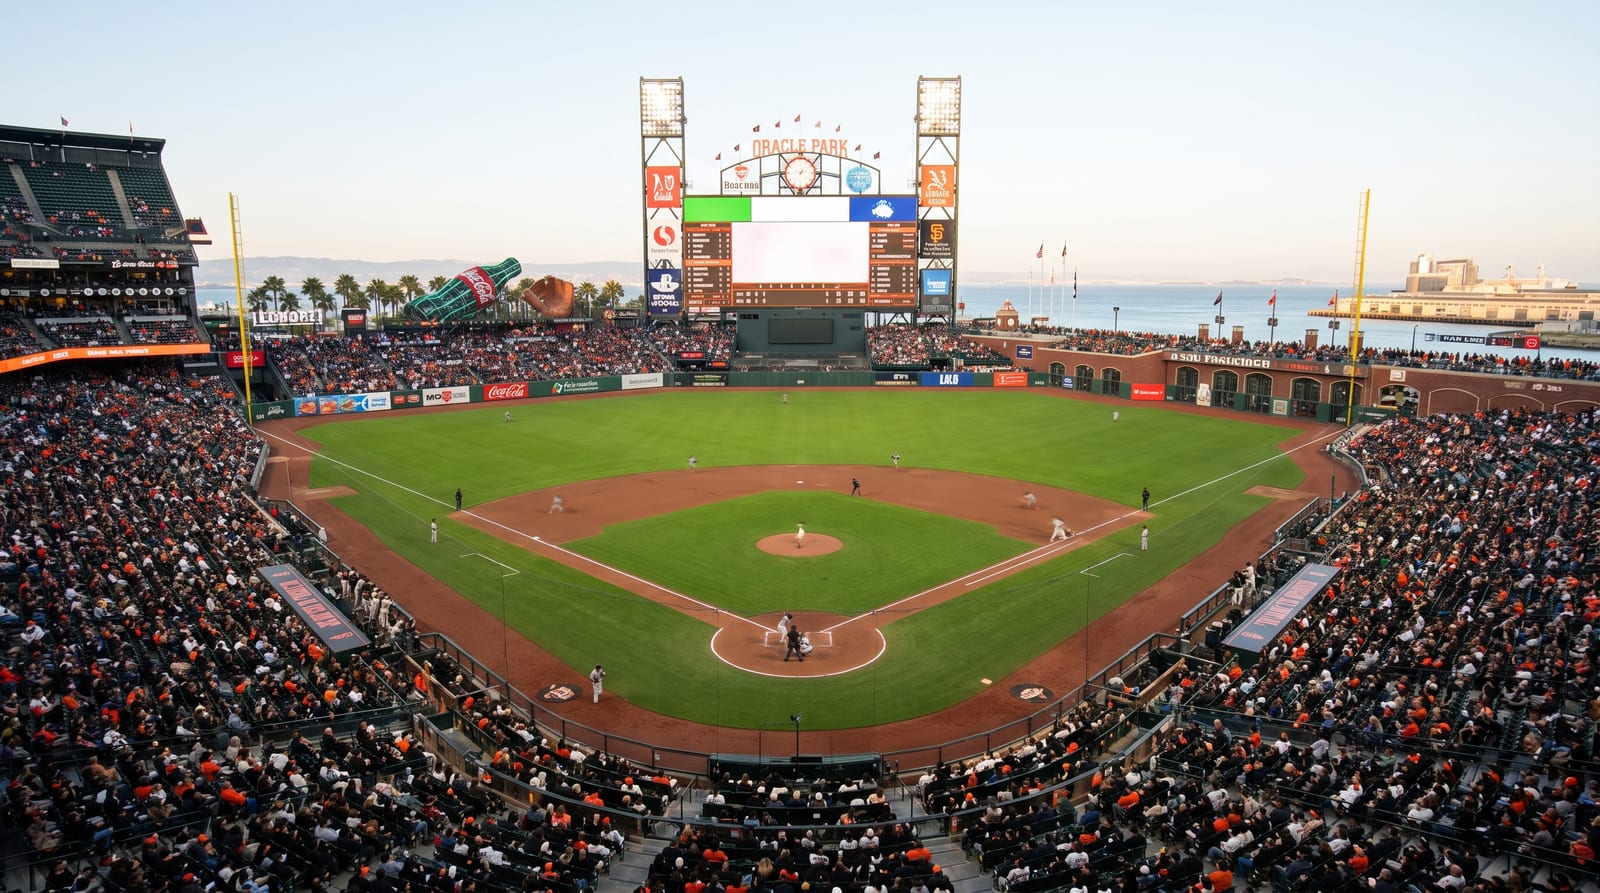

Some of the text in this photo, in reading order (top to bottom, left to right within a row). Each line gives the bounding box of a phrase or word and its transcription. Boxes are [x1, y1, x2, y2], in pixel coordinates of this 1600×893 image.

[752, 138, 848, 158] ORACLE PARK
[488, 384, 526, 399] Coca-Cola
